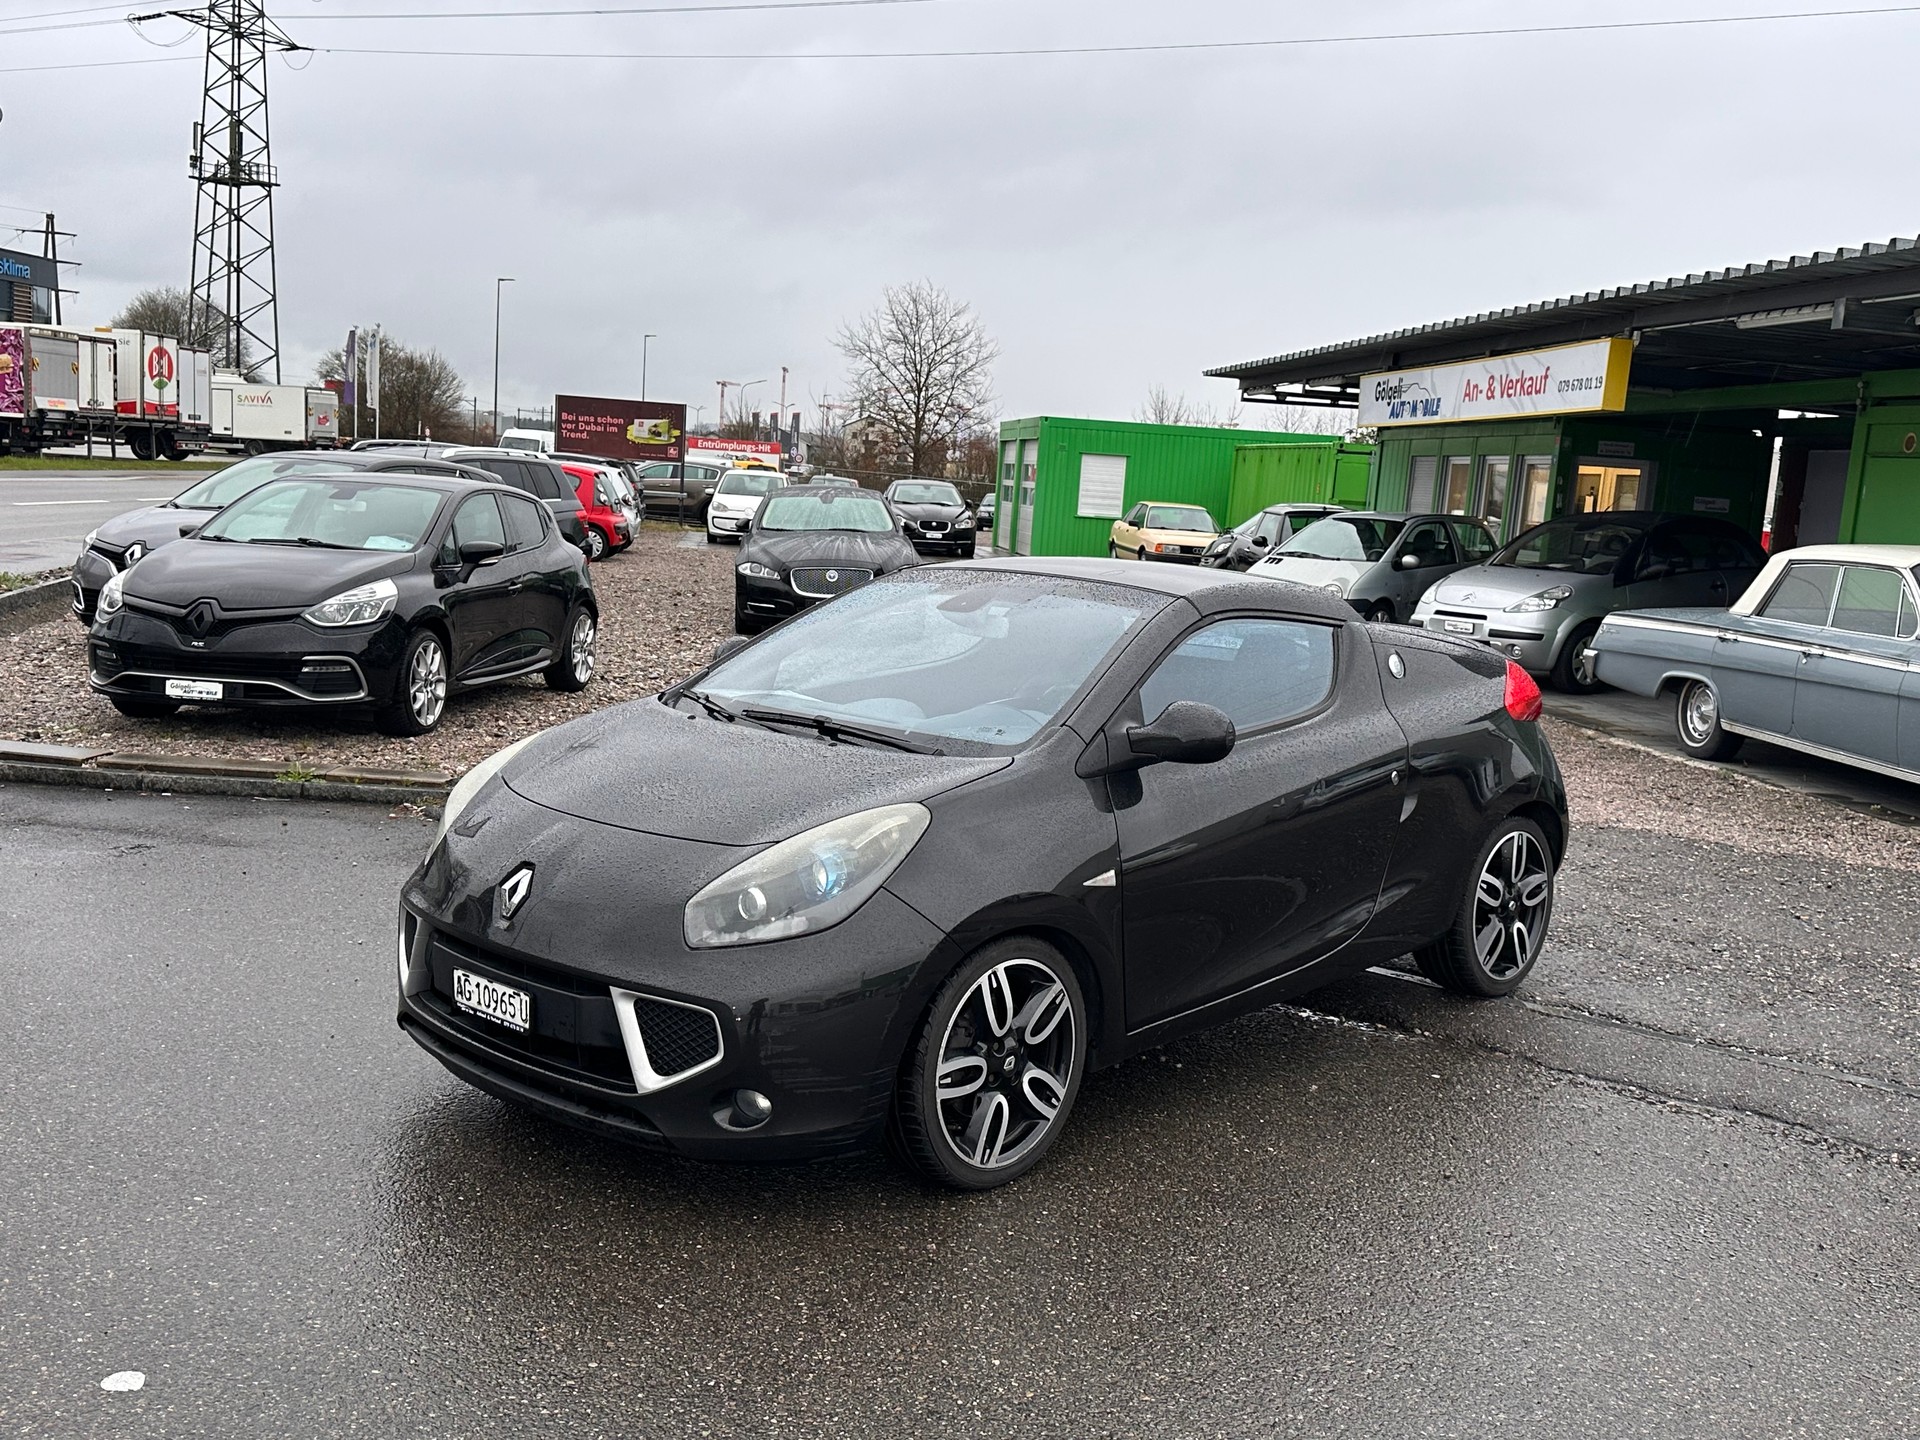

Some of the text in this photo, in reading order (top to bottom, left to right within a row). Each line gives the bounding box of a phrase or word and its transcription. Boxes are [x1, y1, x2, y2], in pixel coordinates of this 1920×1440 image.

[1462, 366, 1551, 403] An- & Verkauf
[1557, 375, 1604, 393] 079 678 01 19
[237, 391, 273, 405] SAVIVA
[1374, 377, 1404, 407] Gölgeli
[561, 412, 624, 425] Bei uns schon
[561, 422, 618, 433] vor Dubai im
[561, 430, 590, 440] Trend.
